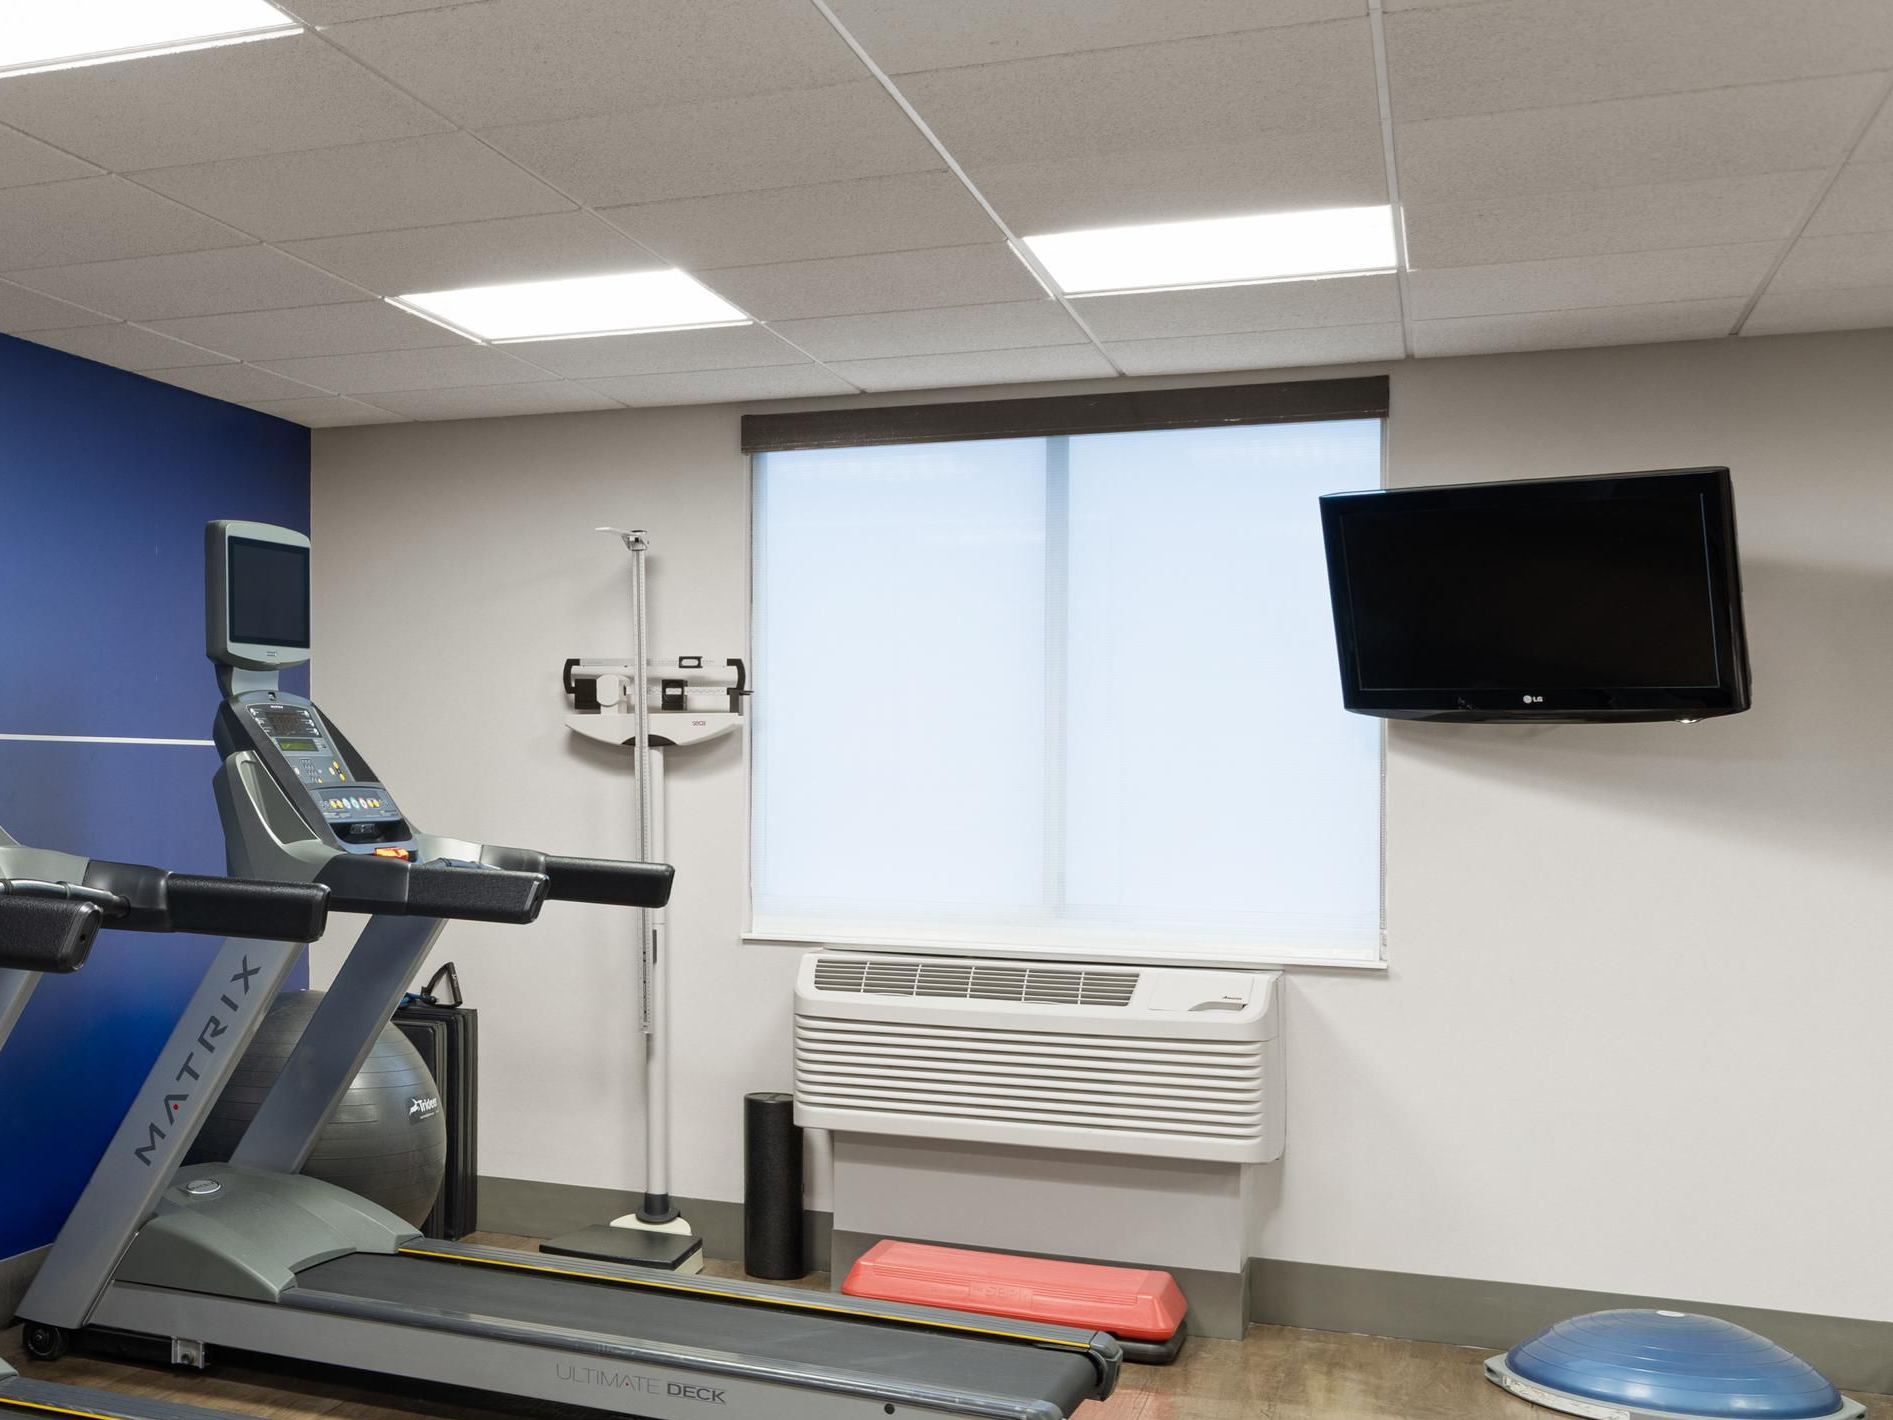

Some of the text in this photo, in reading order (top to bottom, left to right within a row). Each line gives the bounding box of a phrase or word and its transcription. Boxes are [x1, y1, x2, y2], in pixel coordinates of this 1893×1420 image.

[134, 955, 262, 1167] MATRIX
[556, 1362, 727, 1404] ULTIMATE DECK
